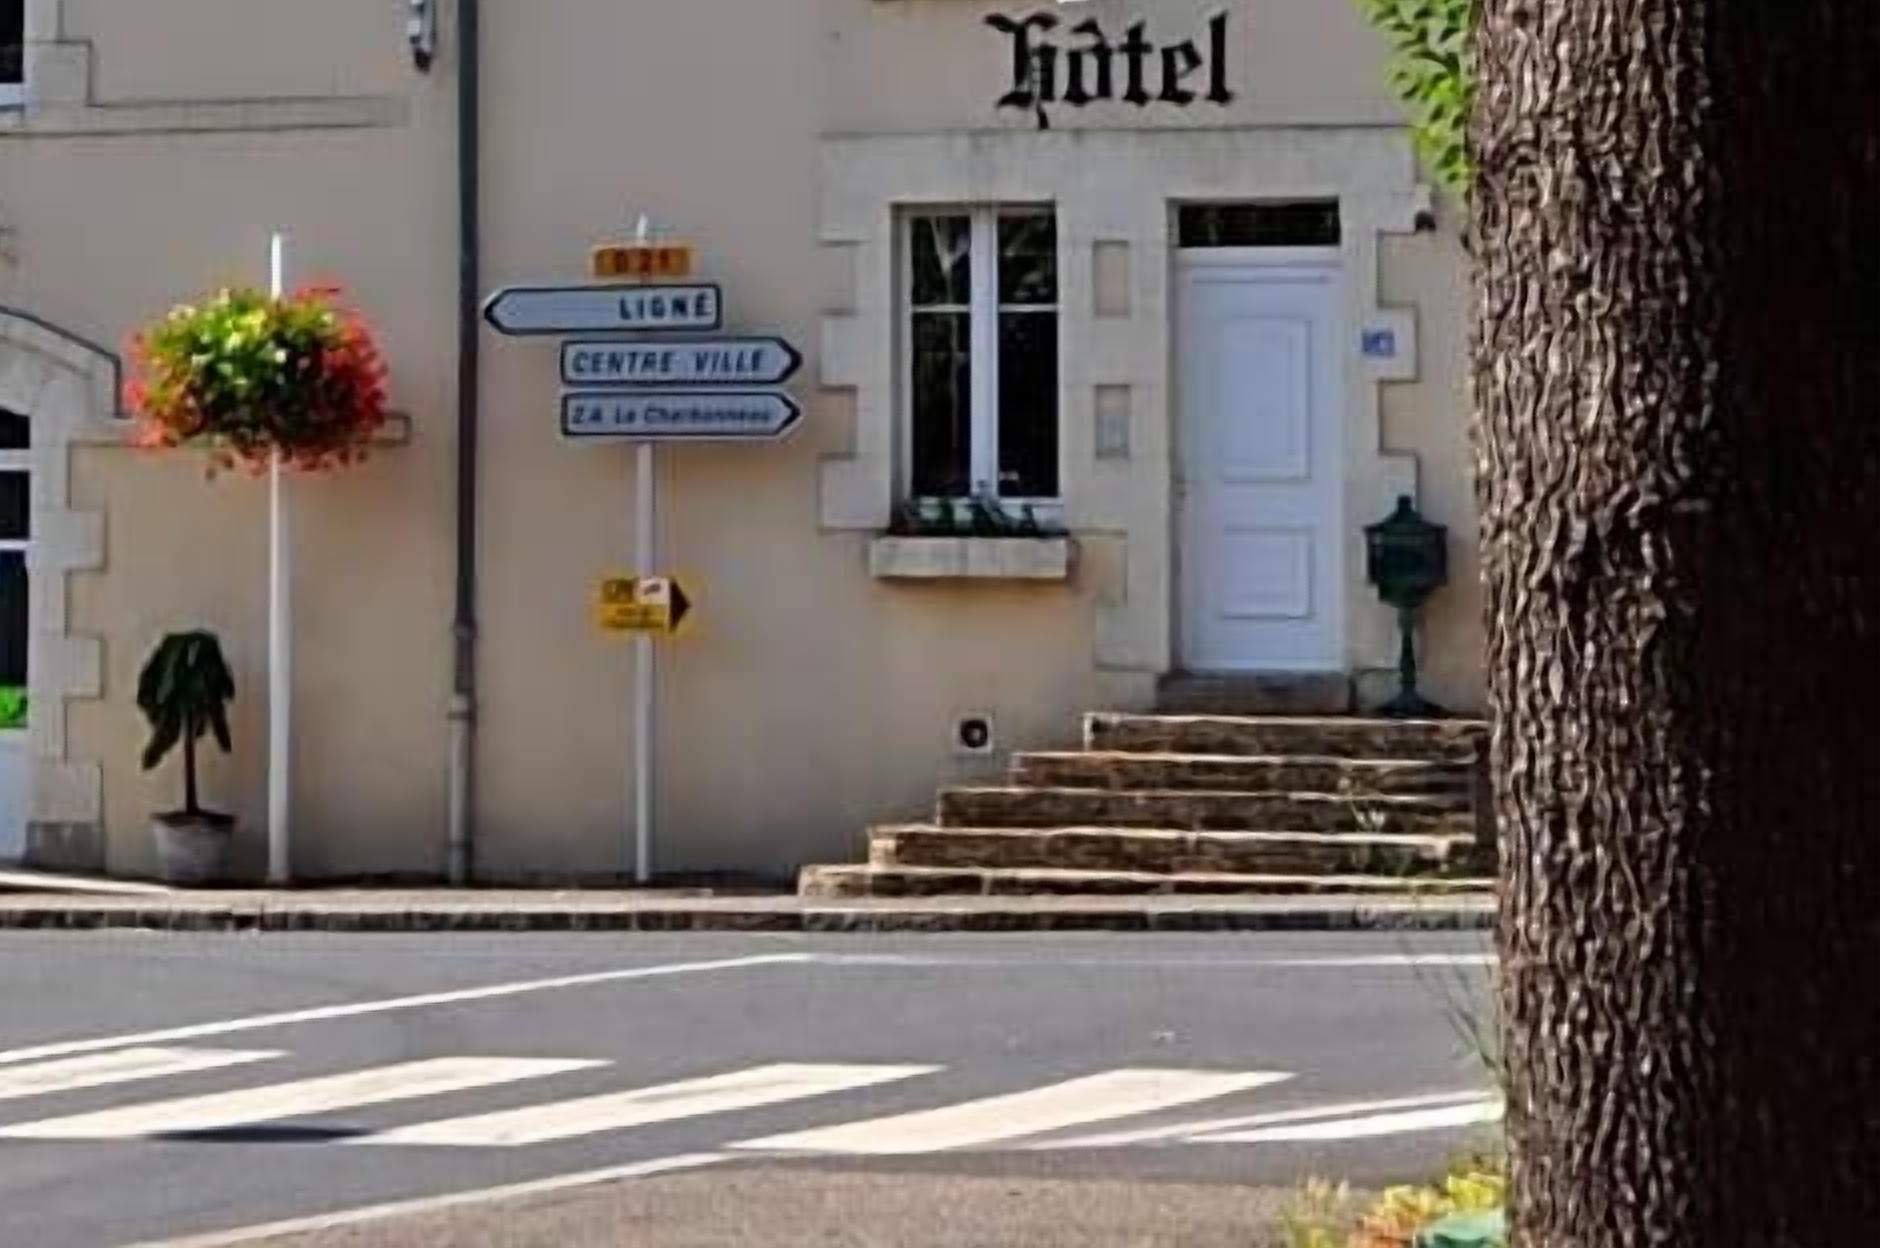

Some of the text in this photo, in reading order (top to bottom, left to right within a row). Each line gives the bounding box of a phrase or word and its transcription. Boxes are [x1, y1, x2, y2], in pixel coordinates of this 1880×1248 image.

[983, 9, 1232, 130] Hôtel
[619, 291, 712, 321] LIGNÉ
[571, 349, 765, 373] CENTRE VILLE
